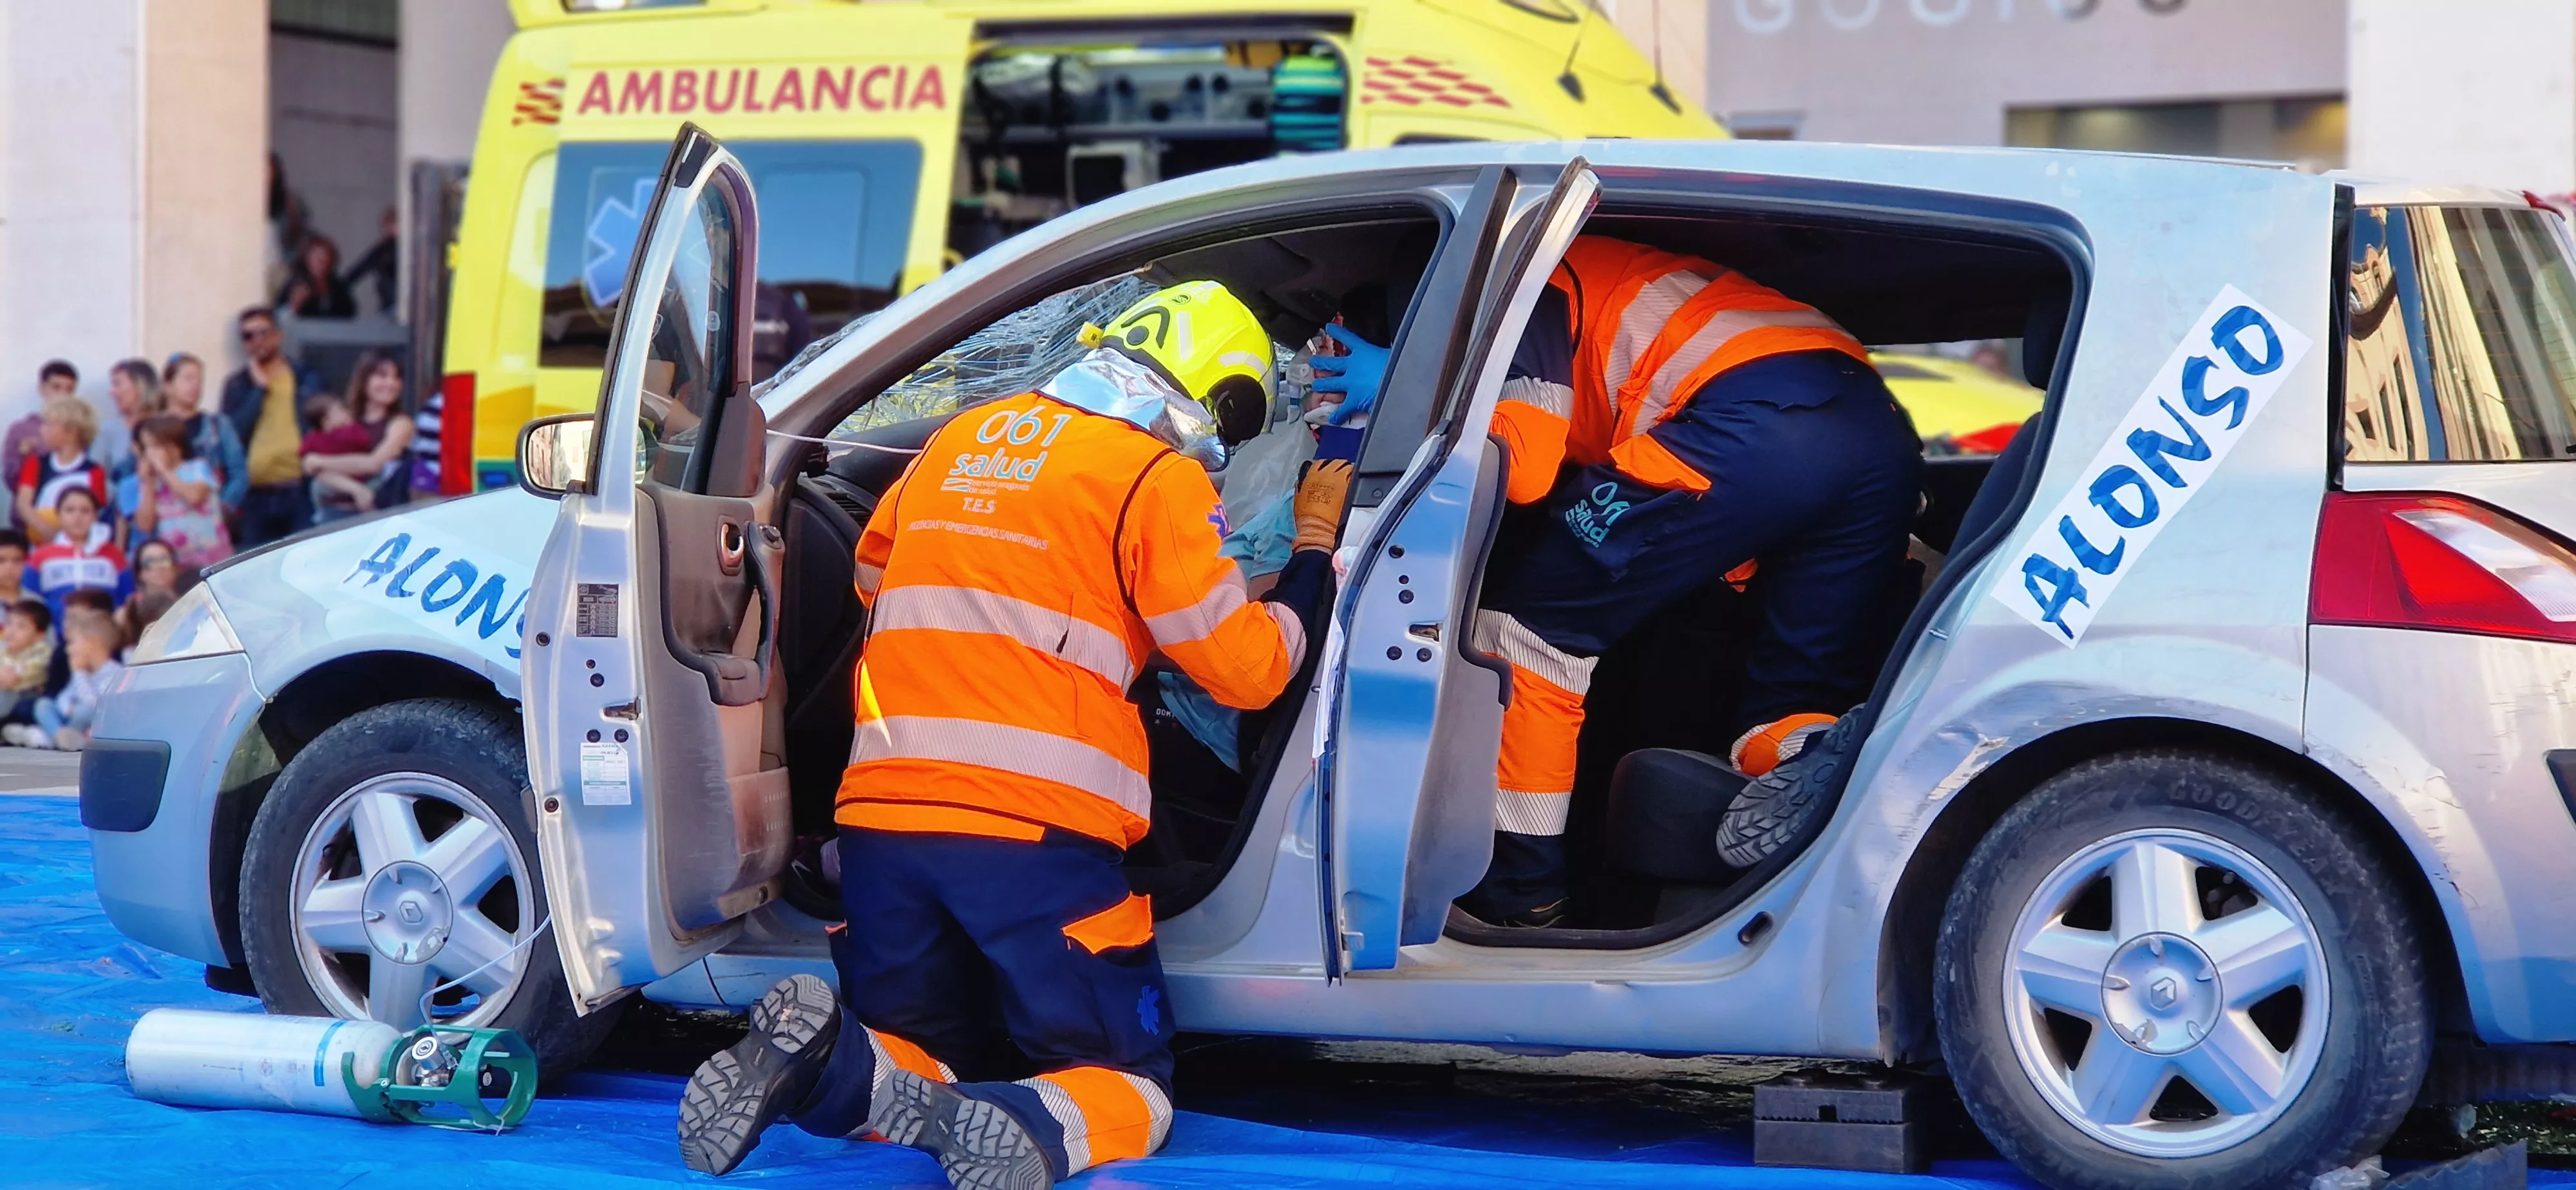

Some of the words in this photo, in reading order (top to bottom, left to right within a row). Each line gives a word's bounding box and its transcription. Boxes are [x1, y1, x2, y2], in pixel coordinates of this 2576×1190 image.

[577, 65, 946, 115] AMBULANCIA
[977, 406, 1072, 447] 061
[949, 447, 1048, 481] salud
[2021, 305, 2284, 640] ALONSO
